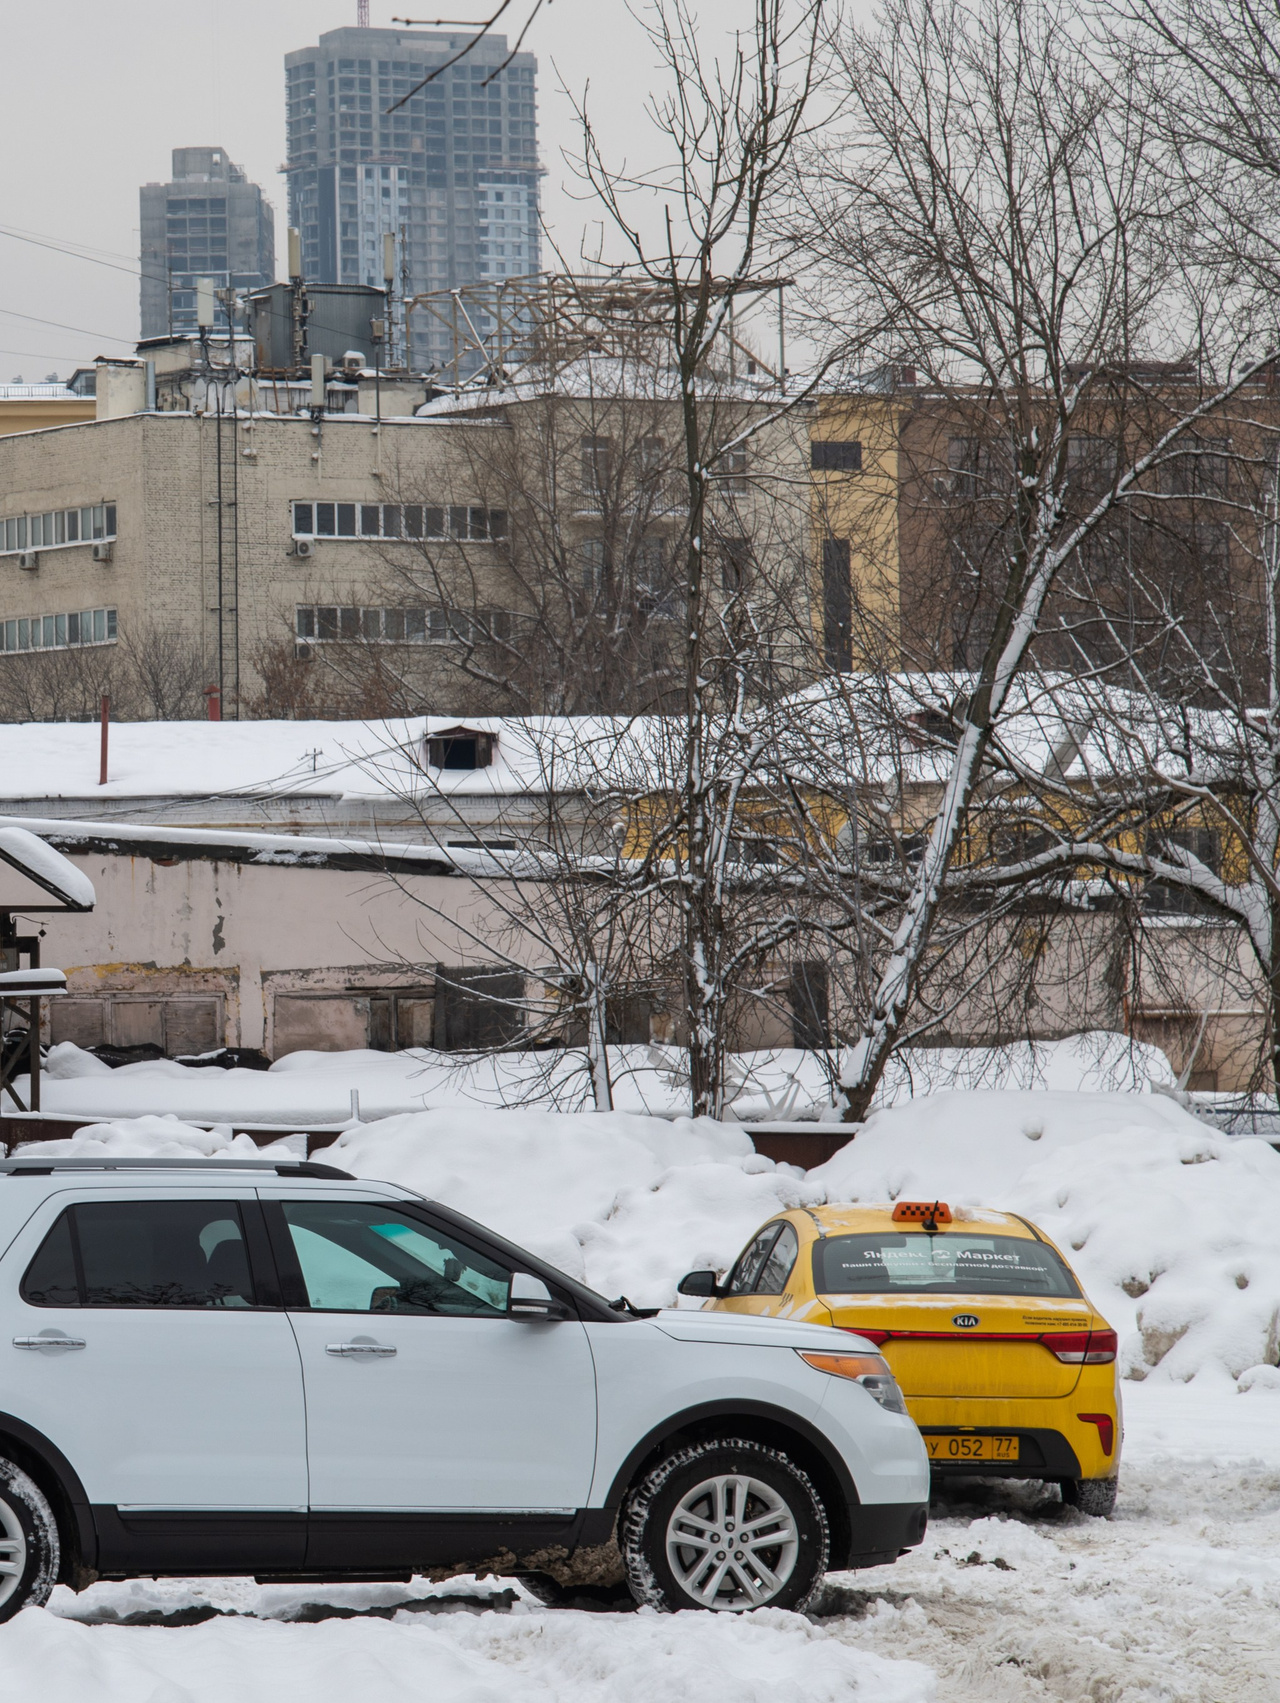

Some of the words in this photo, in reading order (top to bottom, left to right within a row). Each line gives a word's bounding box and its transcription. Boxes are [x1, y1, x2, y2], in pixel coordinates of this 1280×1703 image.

[863, 1250, 927, 1259] Яндекс
[956, 1251, 1020, 1261] Маркет
[957, 1316, 976, 1326] KIA
[948, 1438, 983, 1457] 052
[995, 1438, 1013, 1452] 77
